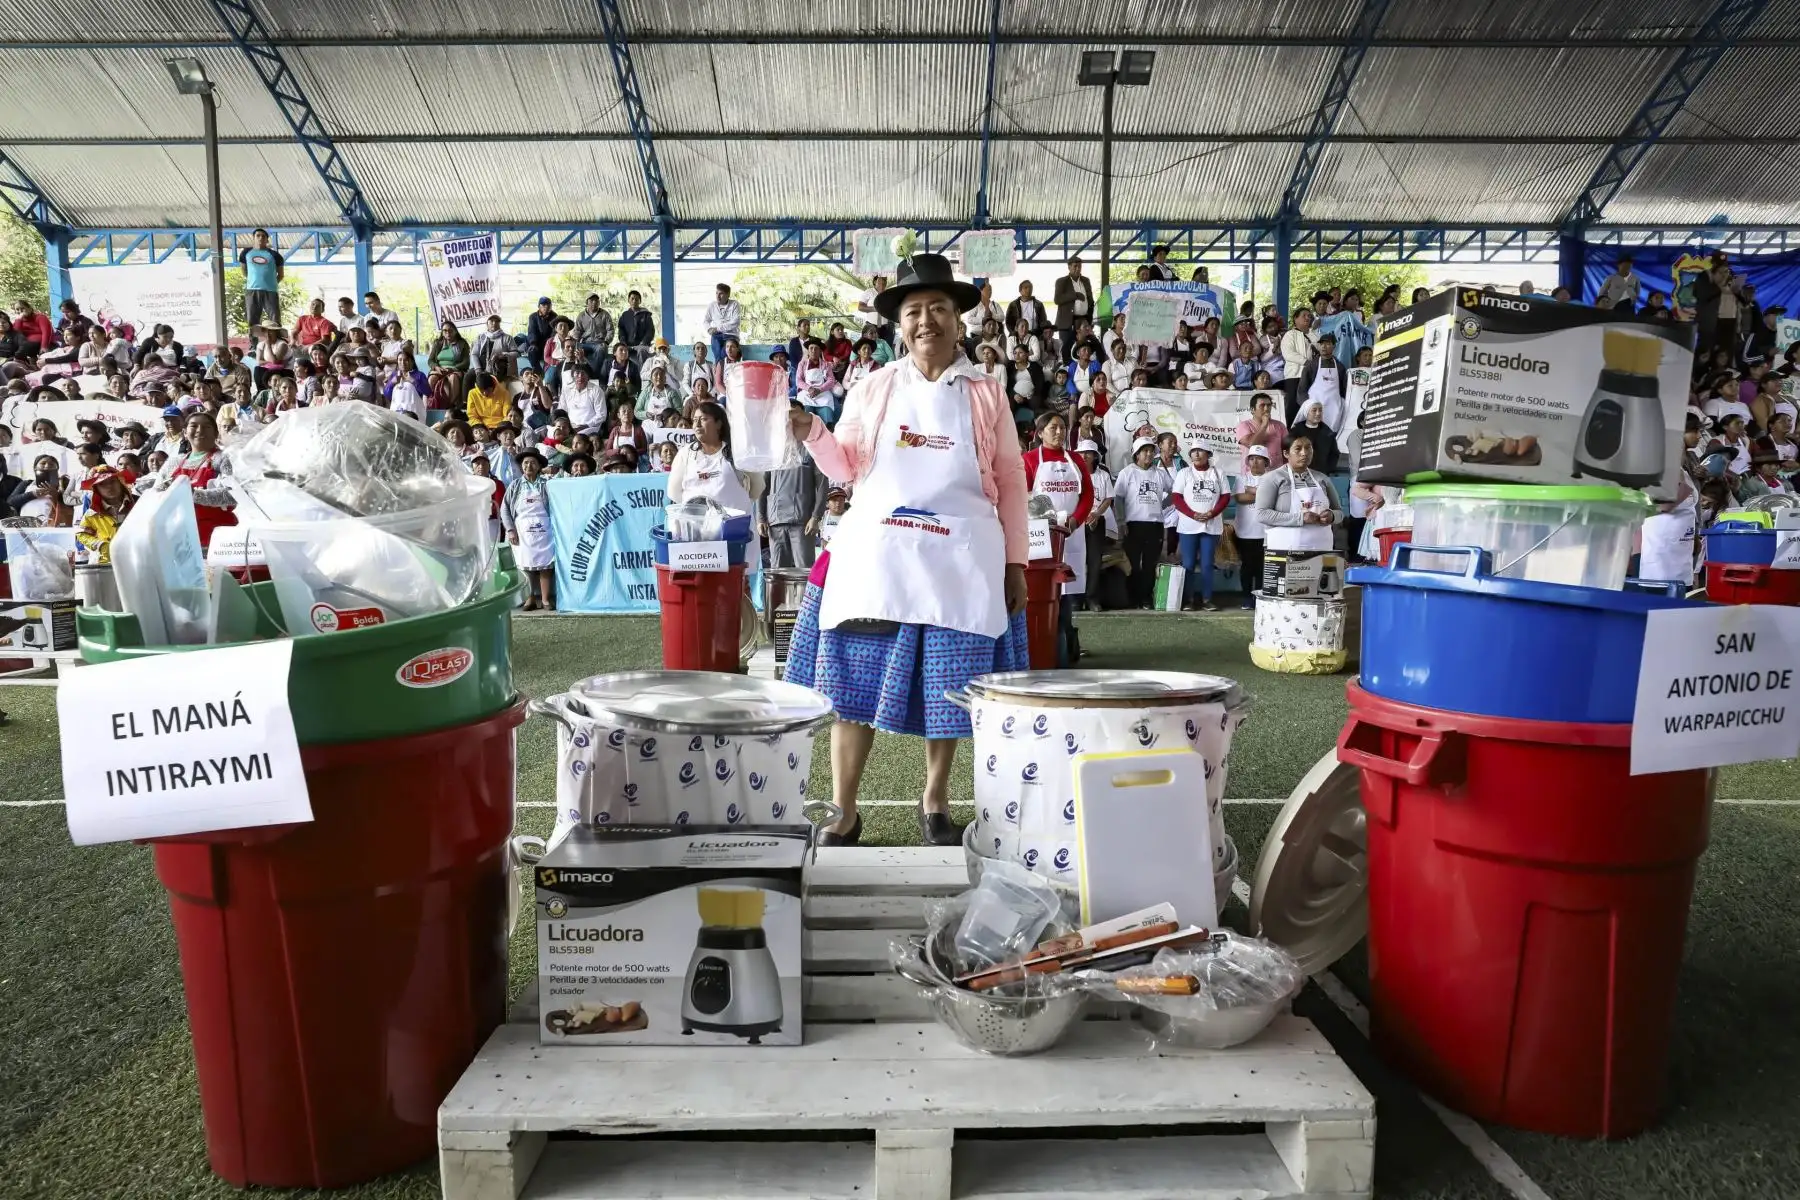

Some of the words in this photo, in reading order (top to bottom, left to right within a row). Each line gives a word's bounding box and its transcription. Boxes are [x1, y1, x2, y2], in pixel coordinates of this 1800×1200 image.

[444, 236, 492, 255] COMEDOR
[448, 251, 493, 269] POPULAR
[1134, 281, 1172, 291] COMEDOR
[1173, 280, 1207, 292] POPULAR
[1183, 300, 1211, 321] Etapa
[1481, 293, 1530, 313] imaco
[1383, 314, 1413, 332] imaco
[1461, 344, 1550, 374] Licuadora
[1457, 386, 1489, 398] Potente
[1490, 391, 1513, 402] motor
[1515, 394, 1526, 404] de
[1527, 396, 1546, 406] 500
[1547, 400, 1570, 410] watts
[1454, 411, 1487, 423] pulsador
[1455, 399, 1481, 410] Perilla
[1482, 402, 1493, 412] de
[1494, 403, 1500, 412] 3
[1502, 405, 1547, 419] velocidades
[1548, 411, 1563, 421] con
[1185, 422, 1226, 433] COMEDOR
[1195, 432, 1210, 440] PAZ
[1211, 434, 1222, 442] DE
[586, 500, 624, 544] MADRES
[880, 517, 914, 528] ARMADA
[921, 523, 951, 536] HIERRO
[577, 537, 593, 556] DE
[613, 550, 657, 570] CARME
[678, 552, 719, 561] ADCIDEPA
[571, 551, 589, 582] CLUB
[627, 583, 657, 600] VISTA
[317, 611, 333, 622] Jor
[353, 616, 380, 625] Balde
[1715, 632, 1755, 654] SAN
[1667, 671, 1760, 698] ANTONIO
[1766, 670, 1793, 690] DE
[112, 711, 144, 740] EL
[152, 691, 252, 735] MANÁ
[1664, 707, 1785, 734] WARPAPICCHU
[106, 752, 273, 797] INTIRAYMI
[689, 841, 780, 849] Licuadora
[560, 870, 614, 883] imaco
[548, 923, 644, 941] Licuadora
[550, 964, 583, 972] Potente
[585, 964, 610, 972] motor
[612, 964, 623, 972] de
[624, 964, 645, 972] 500
[646, 964, 671, 972] watts
[549, 976, 577, 984] Perilla
[578, 976, 589, 984] de
[590, 976, 597, 984] 3
[599, 976, 648, 984] velocidades
[550, 987, 585, 996] pulsador
